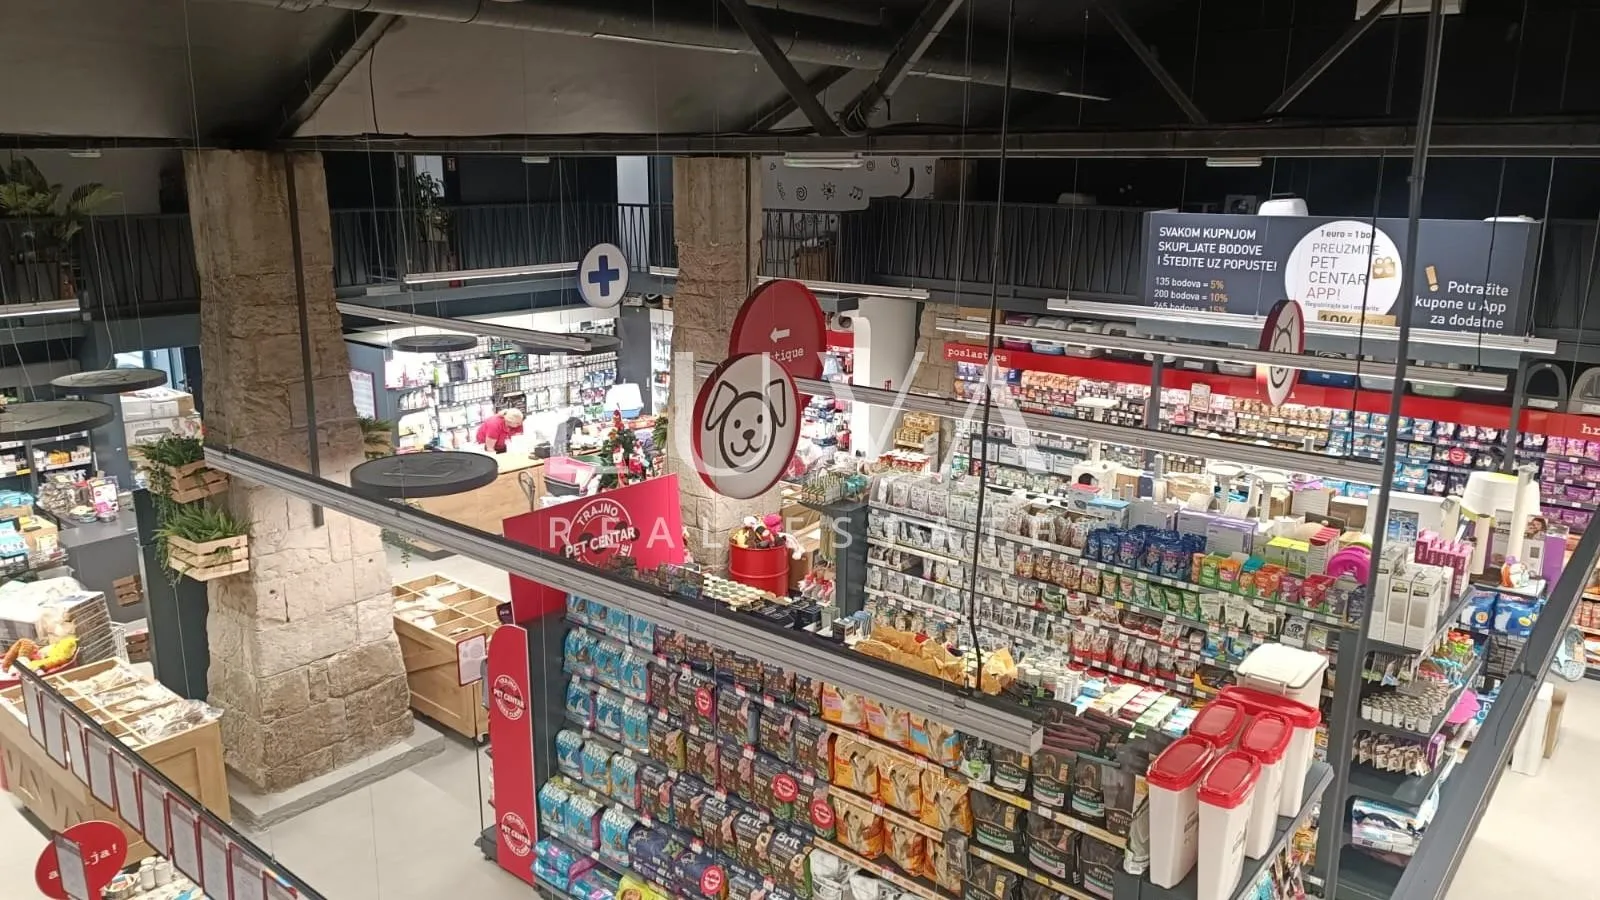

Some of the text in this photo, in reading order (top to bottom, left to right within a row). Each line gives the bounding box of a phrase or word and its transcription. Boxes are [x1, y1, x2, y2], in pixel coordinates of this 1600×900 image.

[1159, 227, 1256, 240] SVAKOM KUPNJOM
[1158, 241, 1263, 256] SKUPLJATE BODOVE
[1312, 243, 1380, 256] PREUZMITE
[1157, 254, 1277, 272] I ŠTEDITE UZ POPUSTE!
[1310, 256, 1339, 269] PET
[1156, 276, 1170, 286] 135
[1171, 278, 1201, 288] bodova
[1210, 279, 1225, 290] 5%
[1309, 271, 1368, 285] CENTAR
[1154, 290, 1169, 298] 200
[1170, 291, 1200, 300] bodova
[1210, 293, 1229, 302] 10%
[1306, 286, 1340, 300] APP!
[1447, 281, 1509, 296] Potražite
[1415, 295, 1507, 315] kupone u App
[1430, 314, 1504, 329] za dodatne
[771, 347, 804, 362] tique
[947, 348, 1008, 362] poslastce
[577, 503, 619, 526] TRAJNO
[565, 542, 587, 559] PET
[589, 527, 637, 553] CENTAR
[776, 831, 801, 849] Brit
